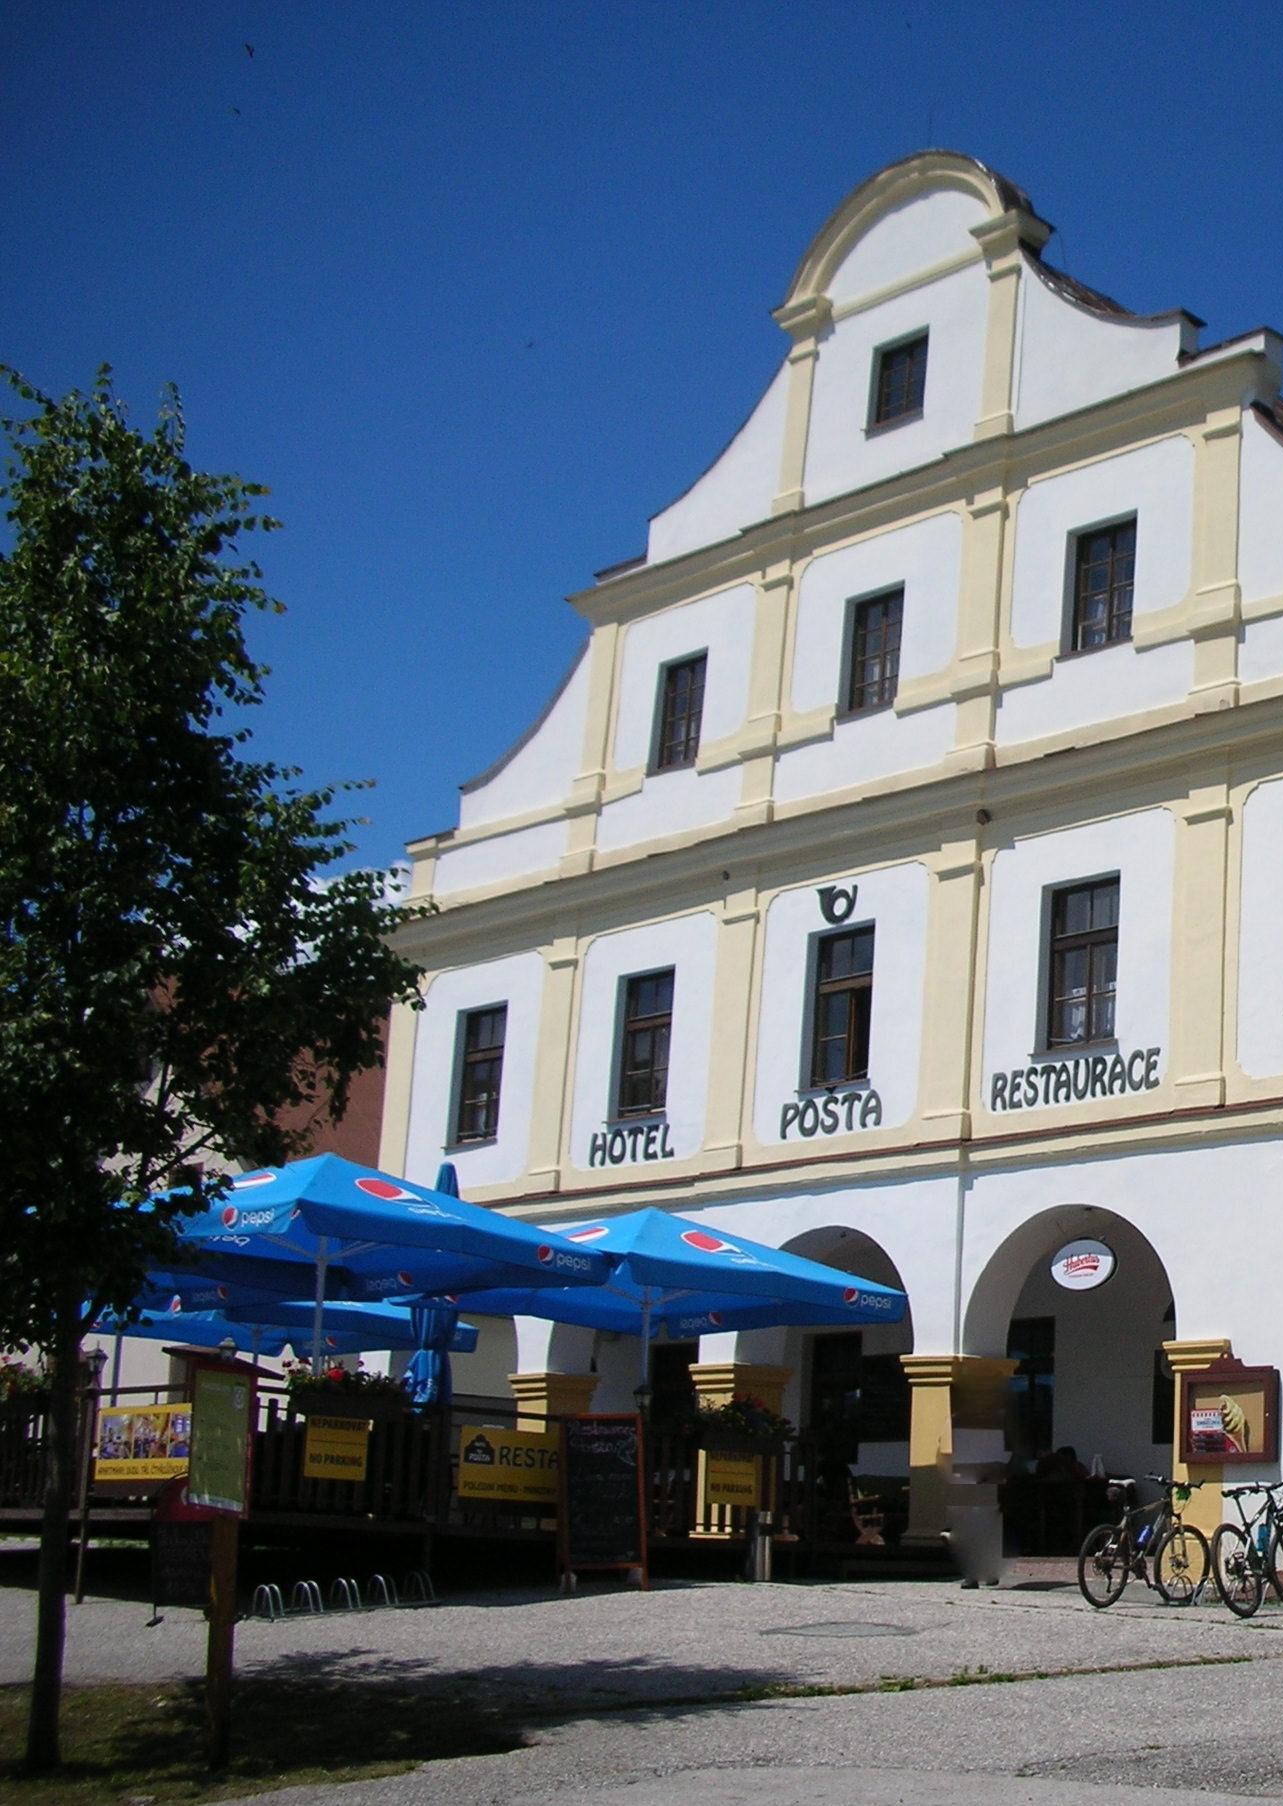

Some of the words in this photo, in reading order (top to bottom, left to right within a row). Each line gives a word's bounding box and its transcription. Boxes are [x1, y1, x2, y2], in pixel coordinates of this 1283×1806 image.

[989, 1047, 1161, 1112] RESTAURACE
[779, 1086, 883, 1140] POŠTA
[588, 1123, 675, 1168] HOTEL
[241, 1208, 275, 1227] pepsi
[556, 1252, 592, 1271] pepsi
[860, 1294, 892, 1310] pepsi
